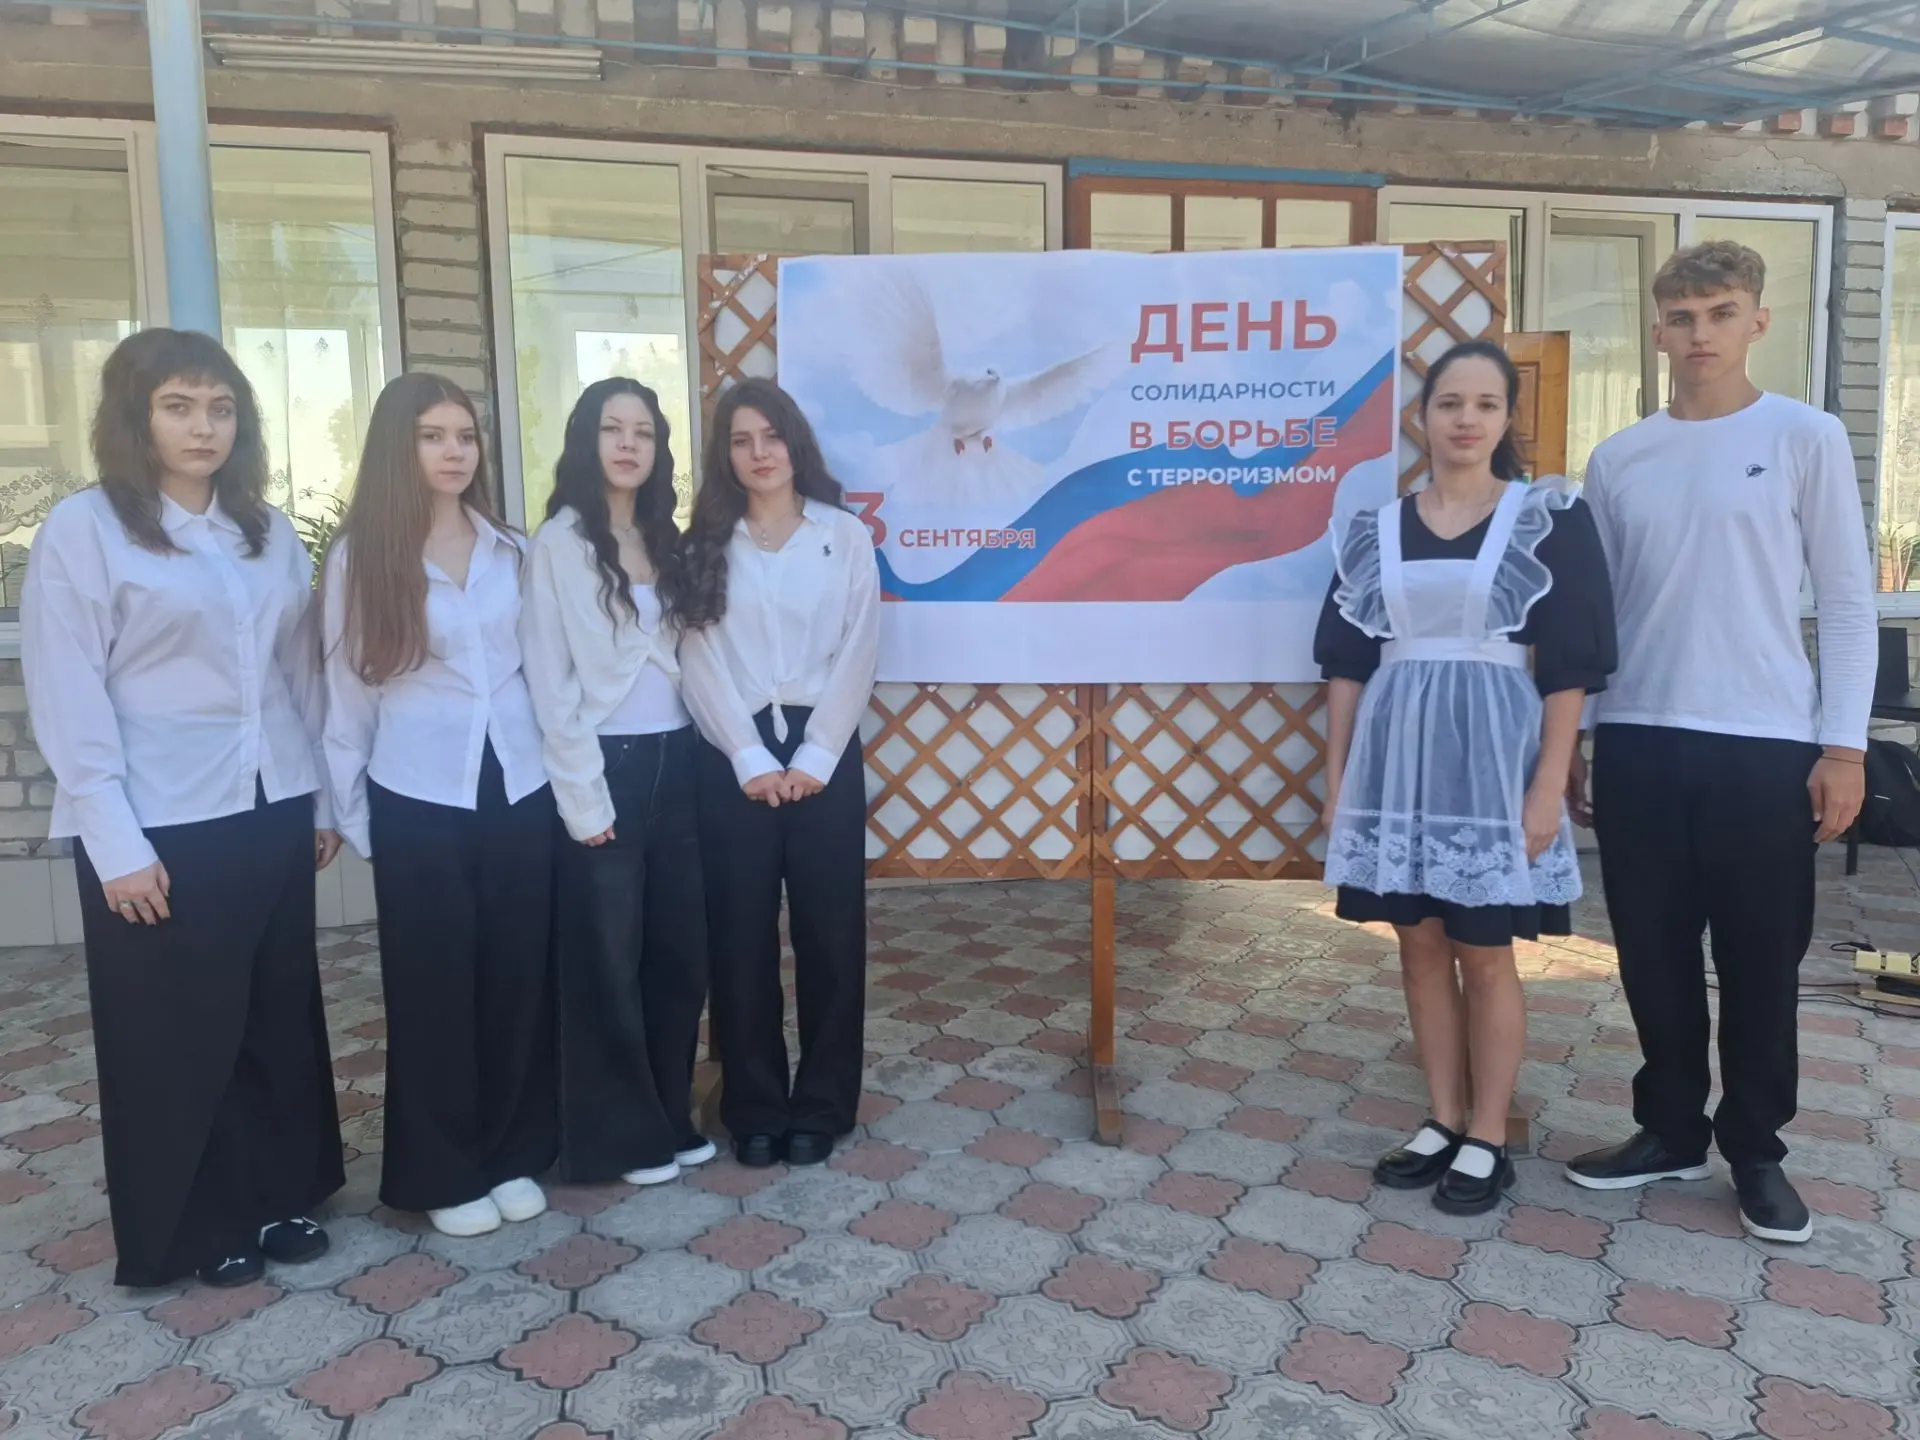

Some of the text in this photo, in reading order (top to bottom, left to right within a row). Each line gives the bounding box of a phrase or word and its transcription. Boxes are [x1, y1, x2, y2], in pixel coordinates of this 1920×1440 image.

[1130, 300, 1337, 363] ДЕНЬ
[1131, 380, 1335, 403] СОЛИДАРНОСТИ
[1129, 417, 1337, 450] В БОРЬБЕ
[1127, 466, 1336, 486] С ТЕРРОРИЗМОМ
[844, 492, 1036, 548] 3 СЕНТЯБРЯ
